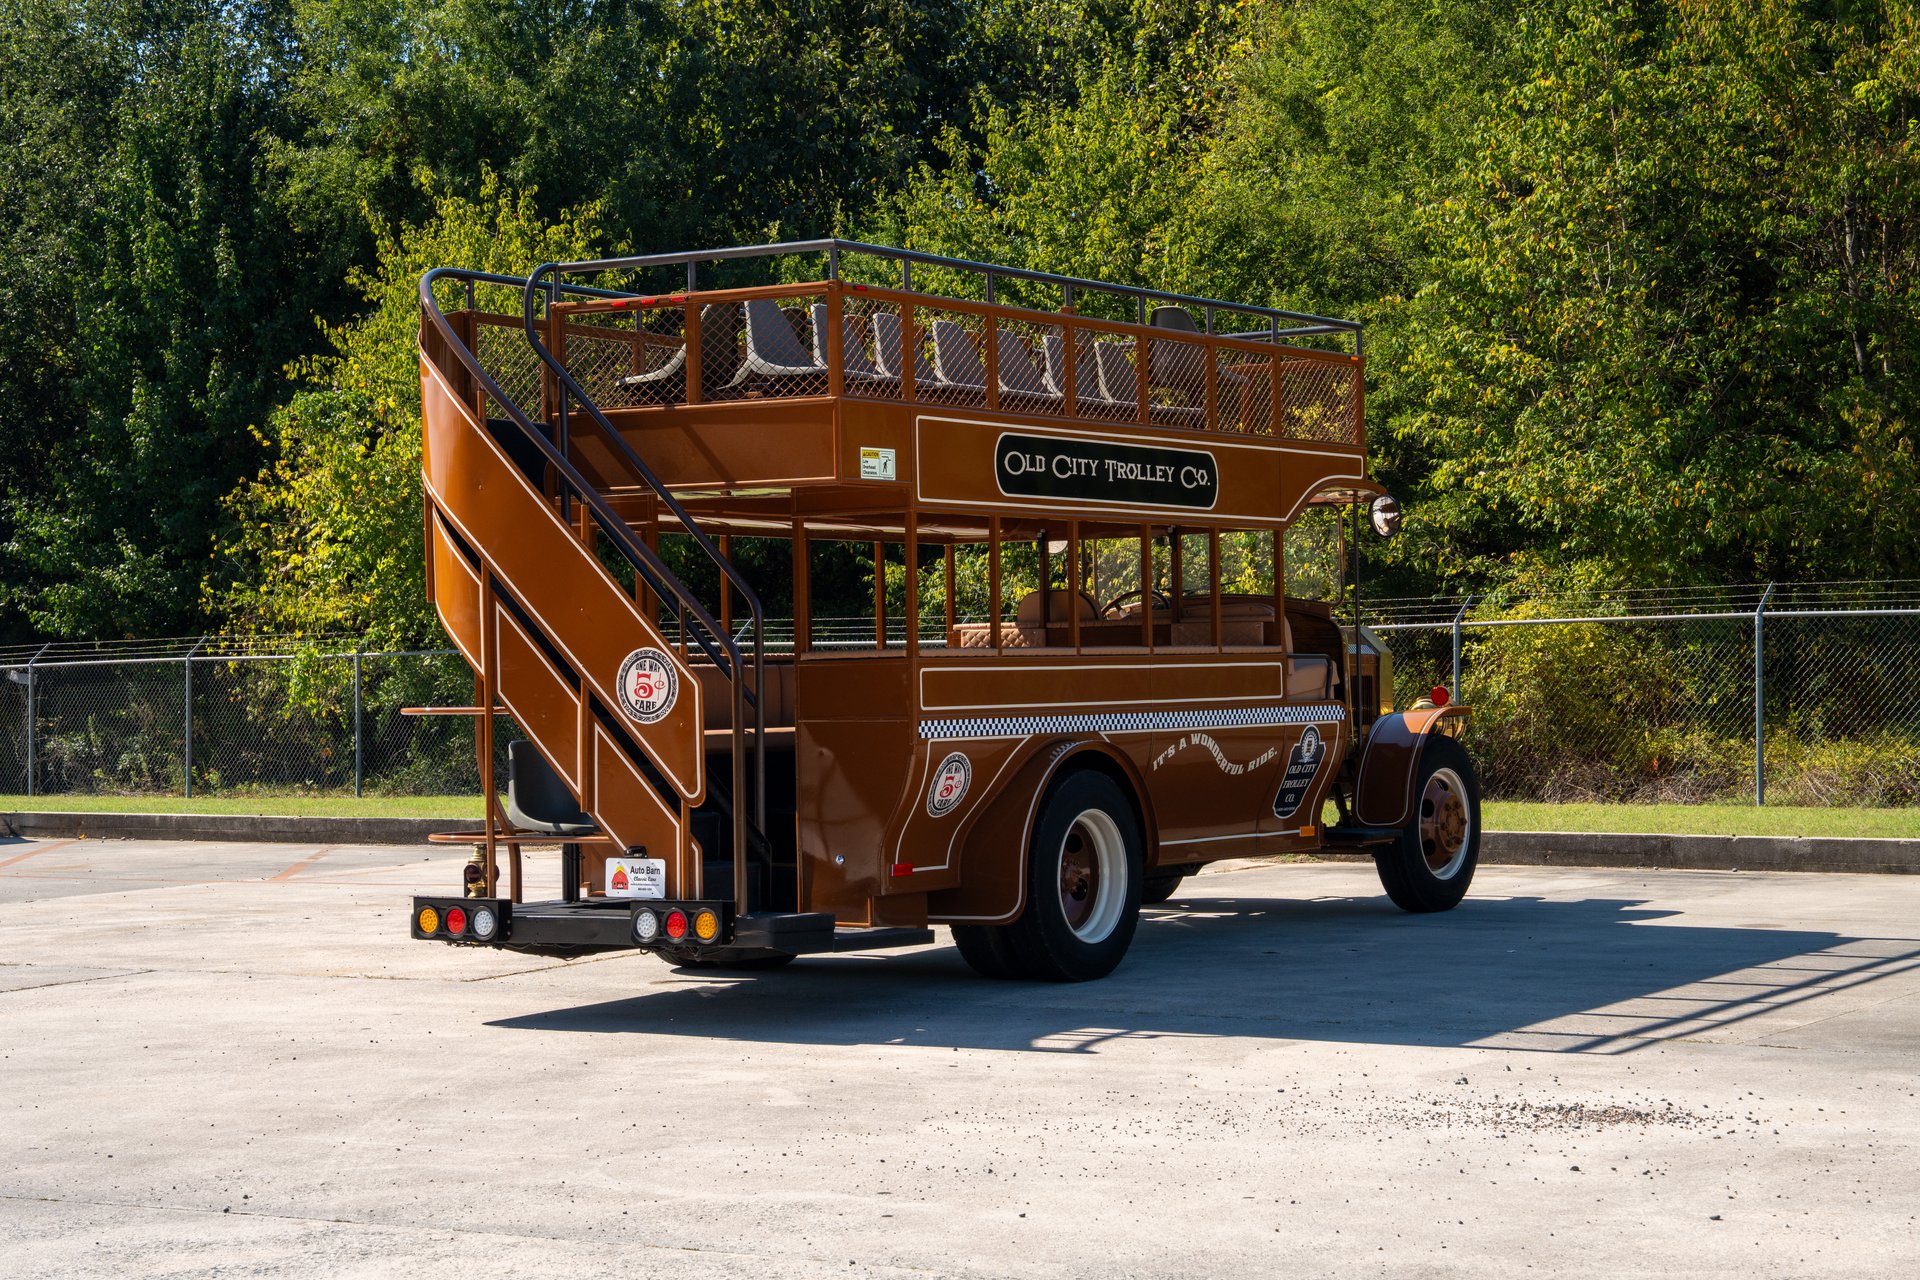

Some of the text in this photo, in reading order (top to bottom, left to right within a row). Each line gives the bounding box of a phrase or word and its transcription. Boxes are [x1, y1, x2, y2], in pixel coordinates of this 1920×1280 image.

[1004, 451, 1046, 475] OLD
[1052, 454, 1100, 479] CITY
[1104, 458, 1175, 483] TROLLEY
[635, 660, 661, 673] ONE WAY
[635, 699, 657, 711] FARE
[1152, 732, 1278, 775] IT'S A WONDERFUL RIDE.
[946, 763, 962, 774] ONE WAY
[1288, 764, 1317, 775] OLD CITY
[1282, 778, 1310, 789] TROLLEY
[936, 798, 952, 808] FARE
[630, 866, 661, 875] Auto Barn
